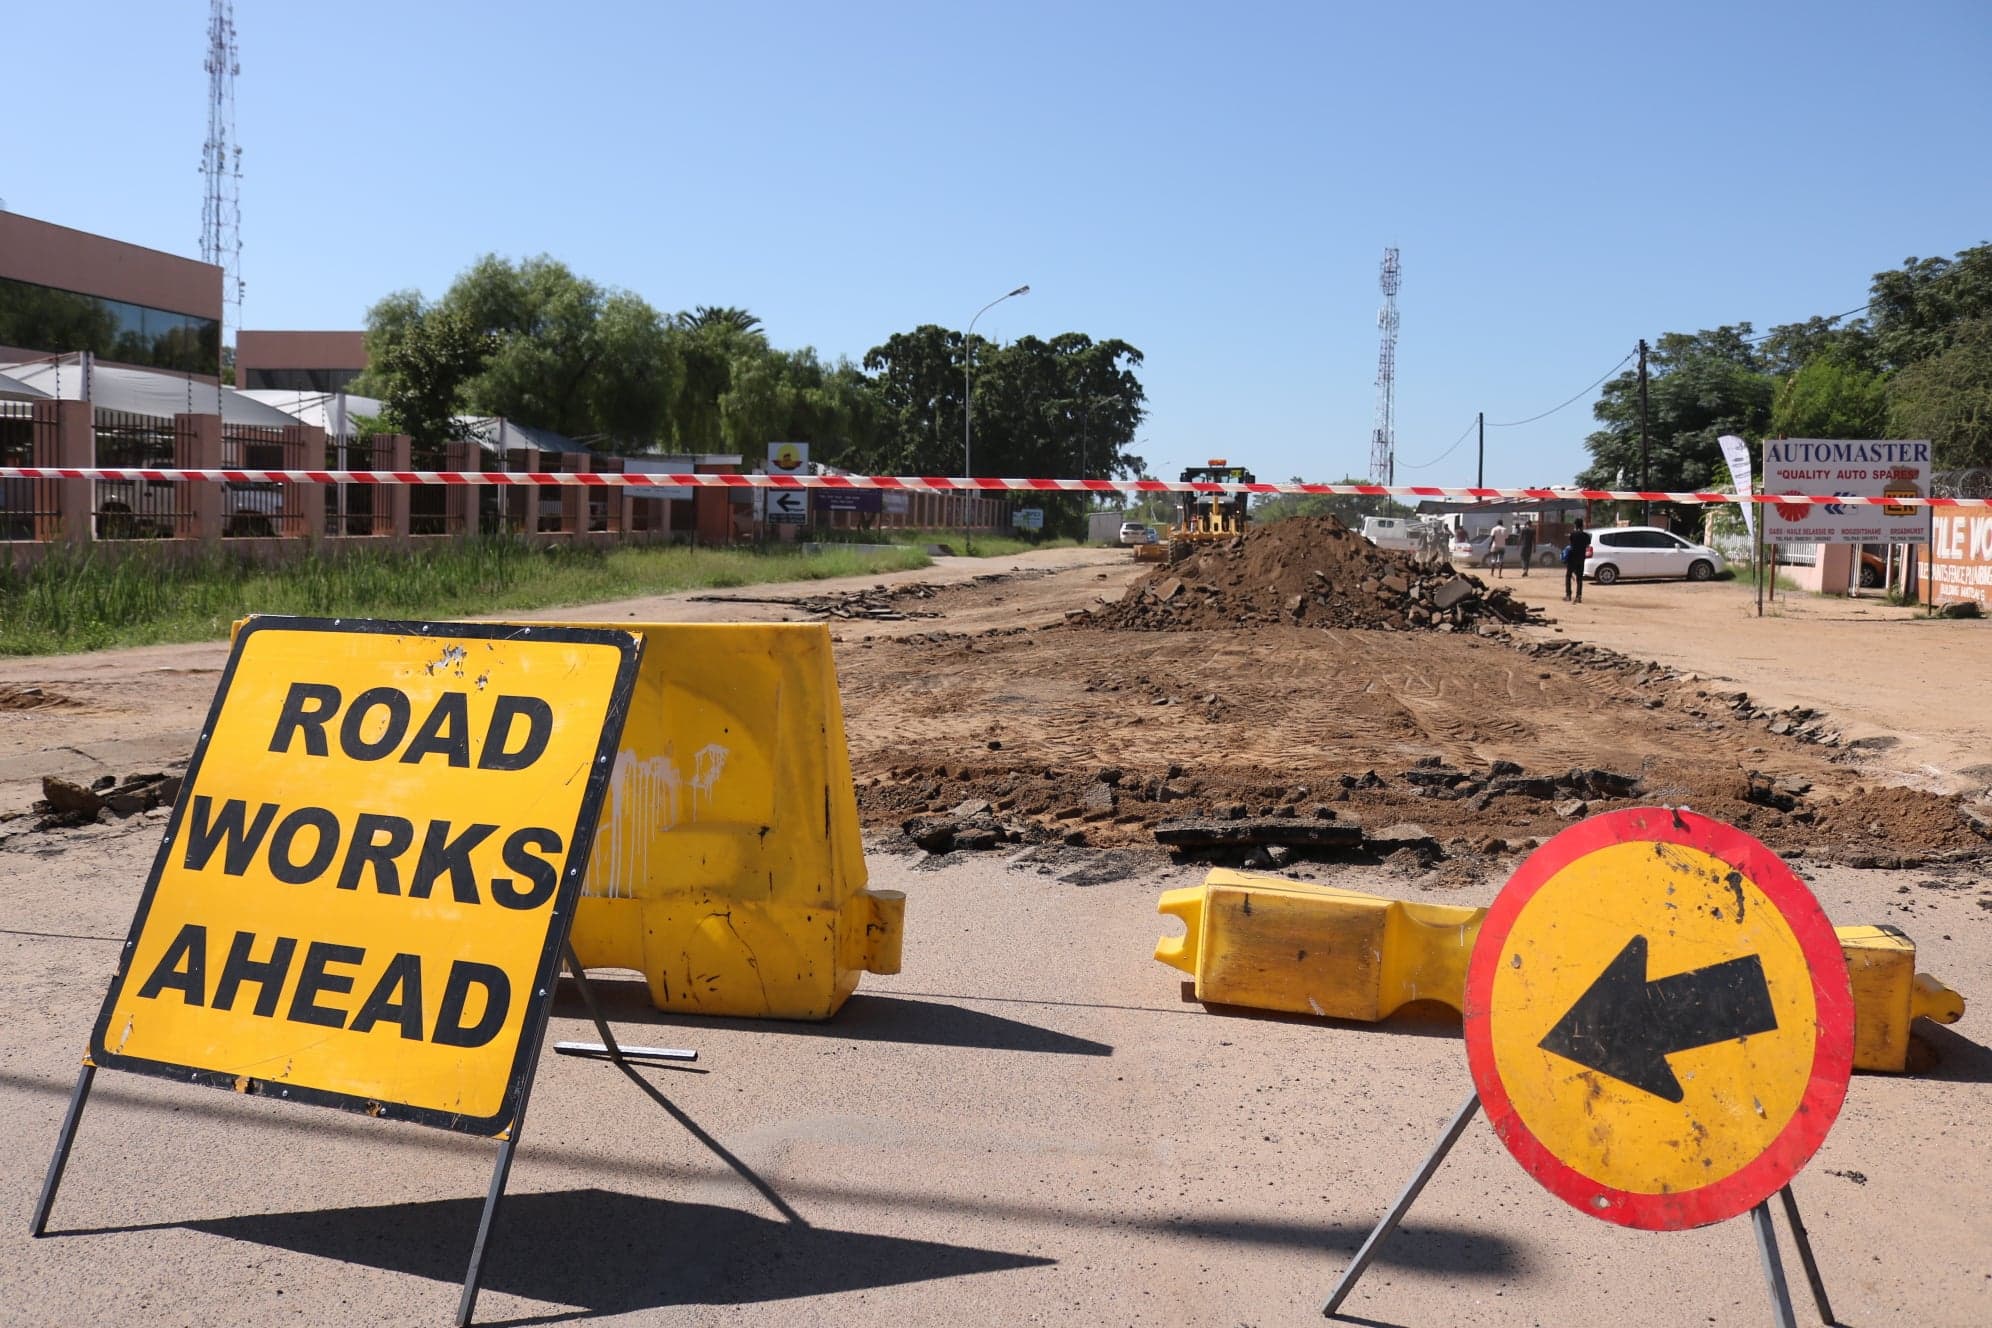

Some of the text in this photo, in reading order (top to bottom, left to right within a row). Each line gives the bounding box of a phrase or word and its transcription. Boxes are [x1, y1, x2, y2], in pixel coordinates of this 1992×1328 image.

[1766, 443, 1929, 462] AUTOMASTER
[1837, 470, 1867, 480] AUTO
[268, 682, 553, 771] ROAD
[183, 795, 563, 910] WORKS
[137, 923, 511, 1048] AHEAD
